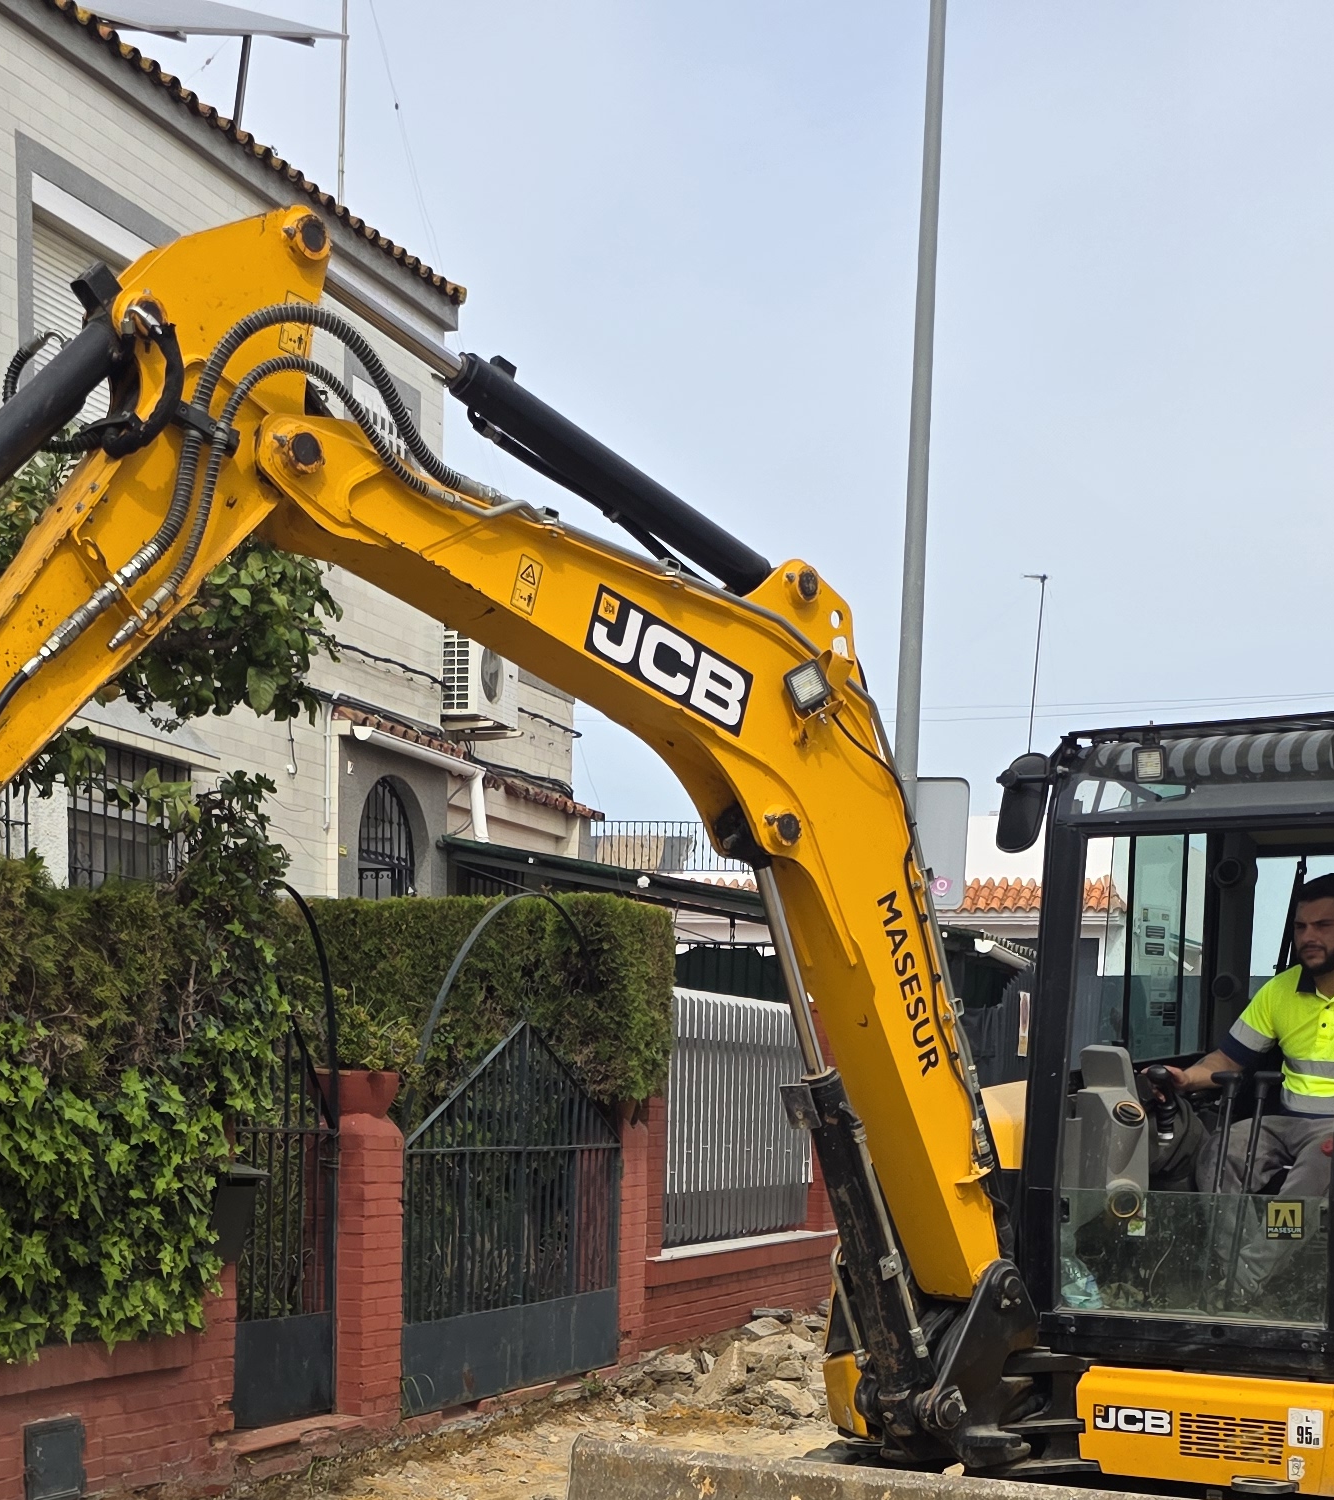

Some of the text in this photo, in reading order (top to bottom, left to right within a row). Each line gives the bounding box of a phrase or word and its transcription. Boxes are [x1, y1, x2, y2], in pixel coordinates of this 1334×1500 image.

[592, 608, 746, 726] JCB
[876, 889, 940, 1078] MASESUR
[1267, 1226, 1302, 1234] MASESUR
[1095, 1407, 1171, 1434] JCB
[1296, 1425, 1313, 1445] 95
